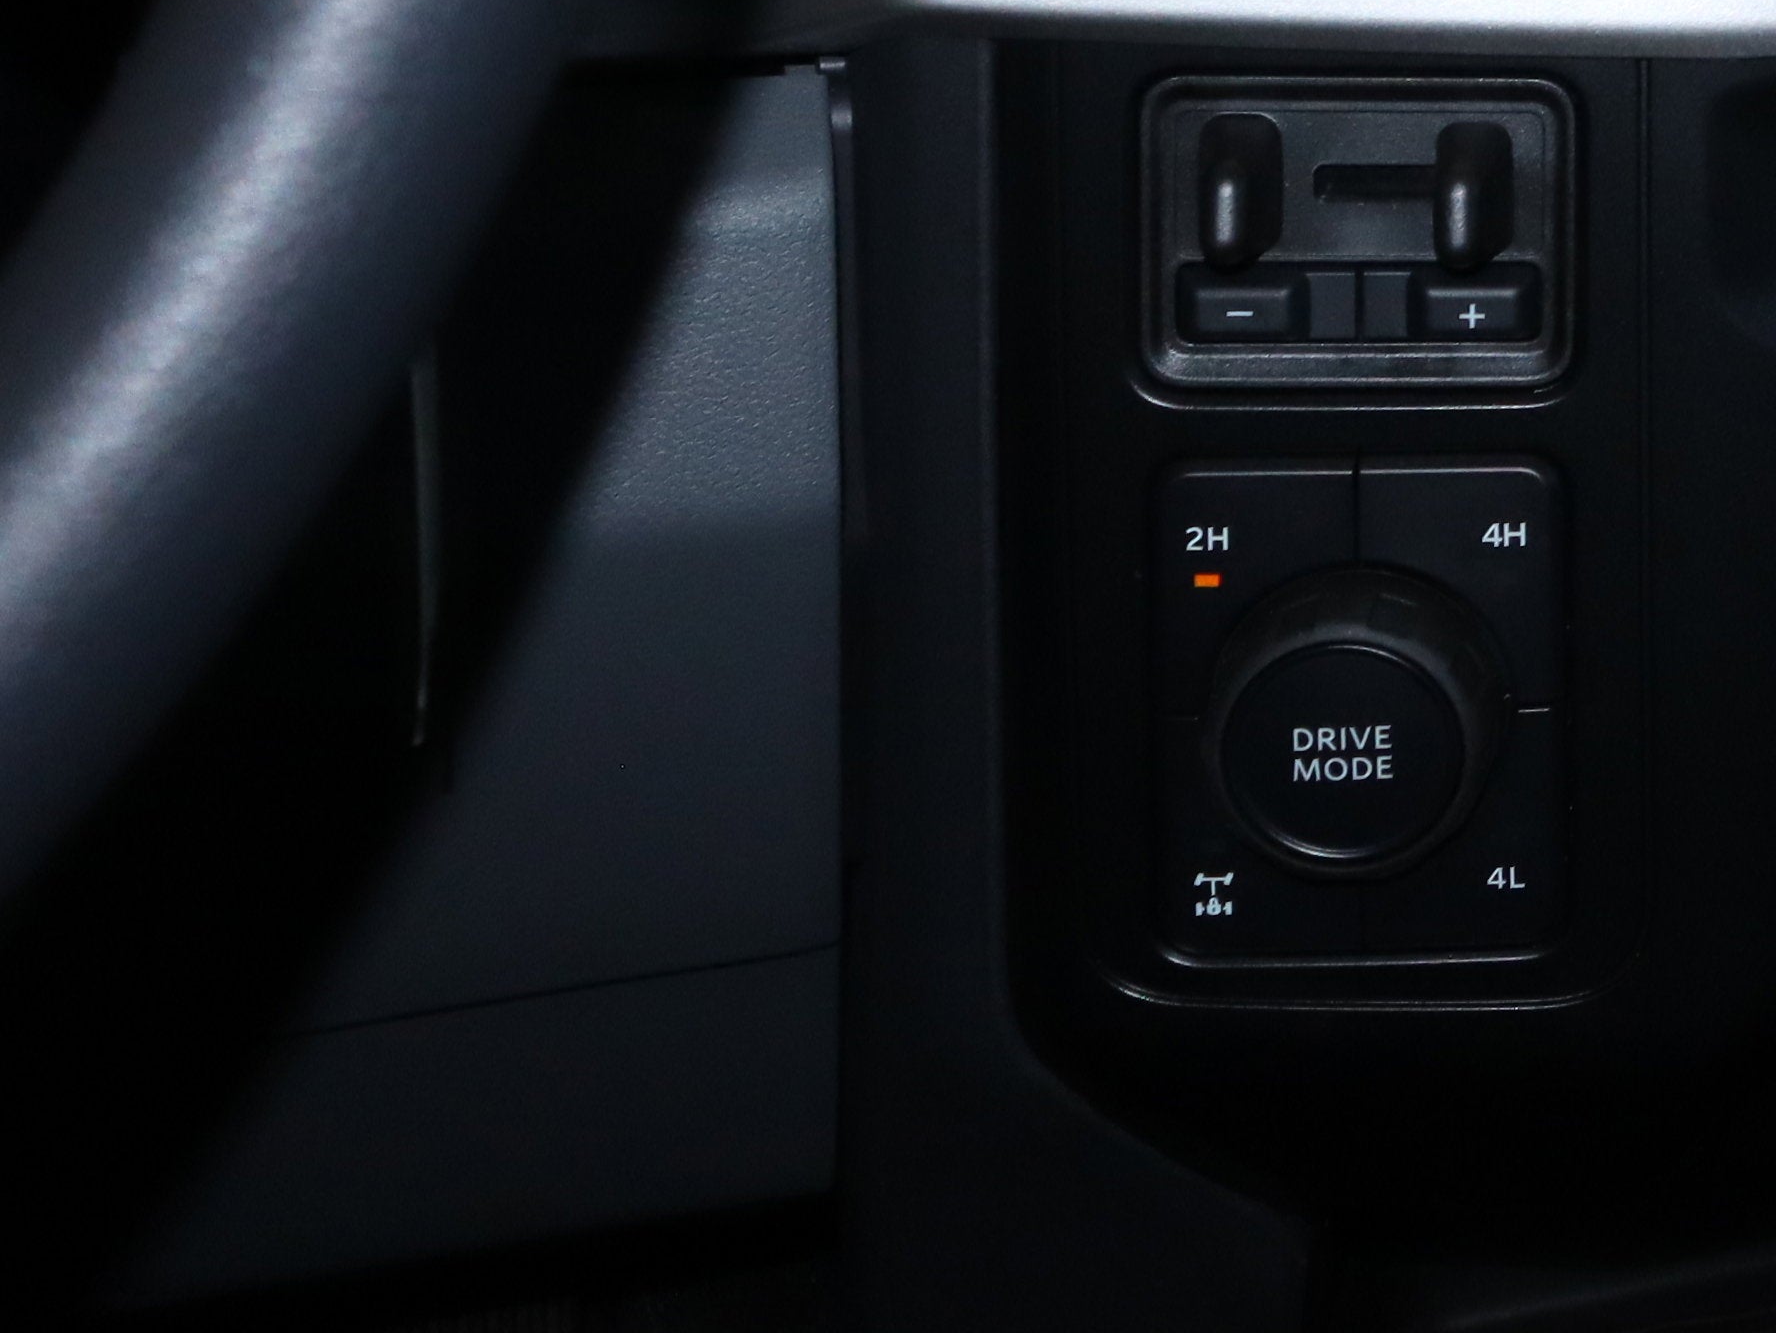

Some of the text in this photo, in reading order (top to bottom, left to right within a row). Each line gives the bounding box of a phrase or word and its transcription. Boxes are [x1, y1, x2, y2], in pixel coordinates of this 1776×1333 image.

[1185, 526, 1229, 551] 2H
[1481, 522, 1526, 548] 4H
[1293, 724, 1392, 752] DRIVE
[1293, 755, 1394, 782] MODE
[1486, 866, 1526, 890] 4L
